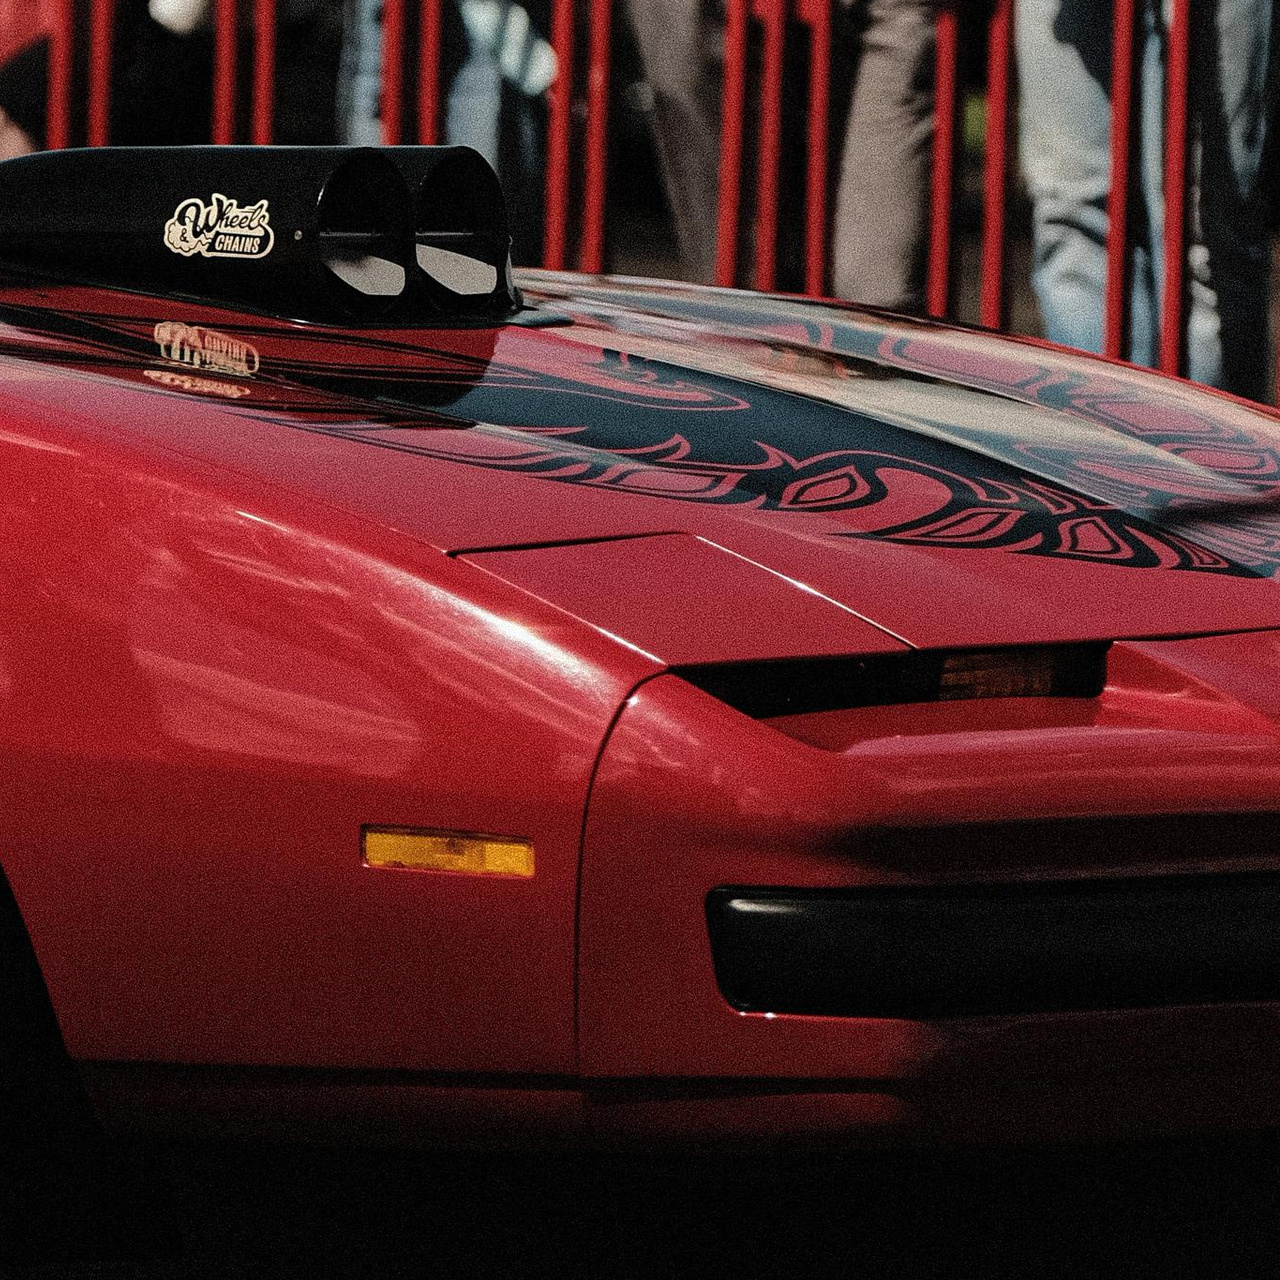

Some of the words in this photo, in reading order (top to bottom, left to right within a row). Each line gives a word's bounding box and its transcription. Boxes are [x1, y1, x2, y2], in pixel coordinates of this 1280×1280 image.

[177, 197, 266, 239] Wheels
[180, 228, 189, 243] &
[215, 234, 261, 254] CHAINS
